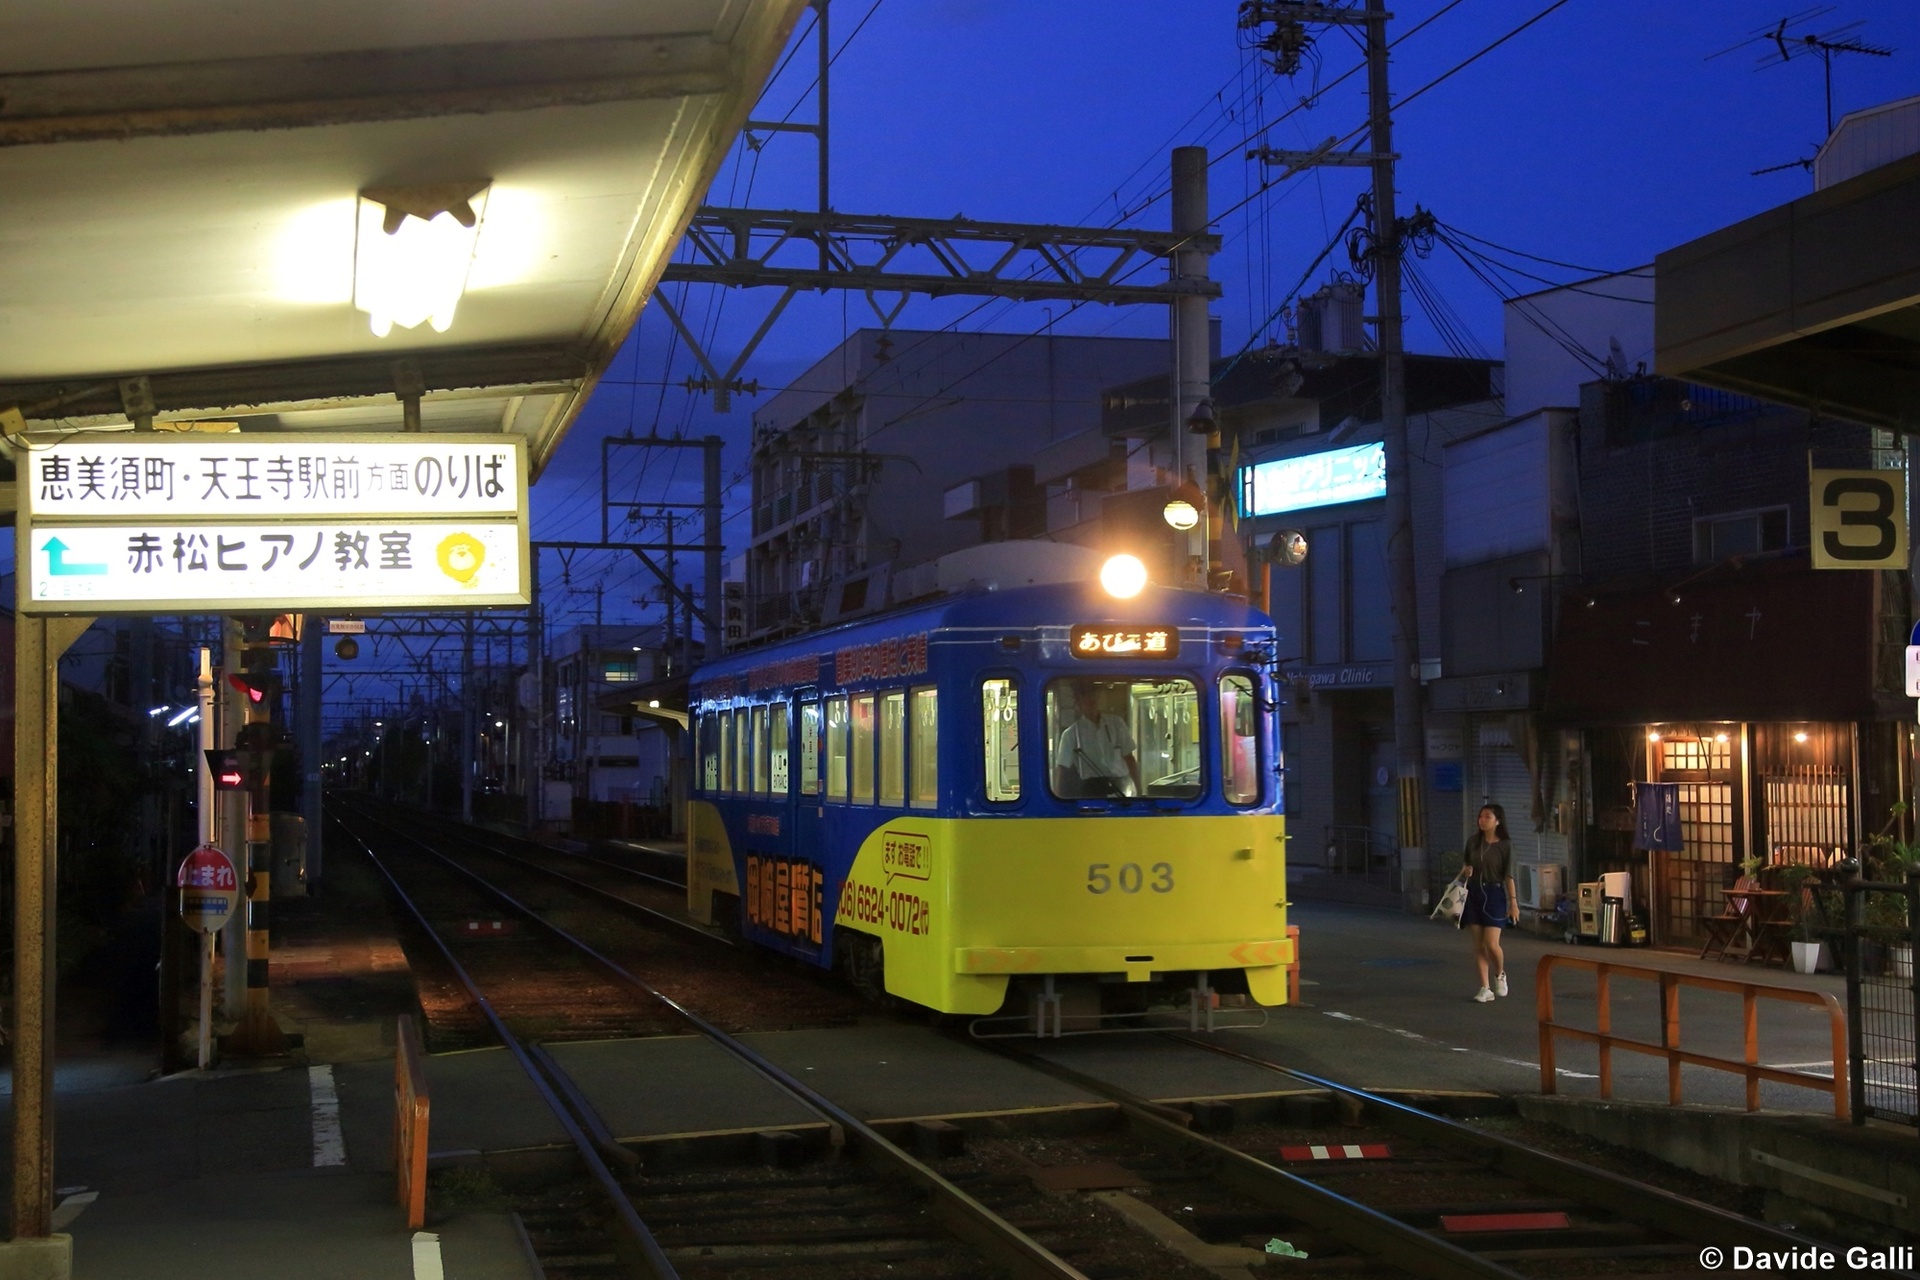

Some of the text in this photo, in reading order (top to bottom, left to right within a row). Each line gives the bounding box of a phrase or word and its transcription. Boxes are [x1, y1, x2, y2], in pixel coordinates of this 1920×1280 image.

[41, 454, 507, 501] 恵美須町・天王寺駅前方面のりば
[1823, 477, 1896, 561] 3
[1340, 668, 1373, 684] Clinic
[178, 864, 233, 887] 止まれ
[1087, 862, 1175, 895] 503
